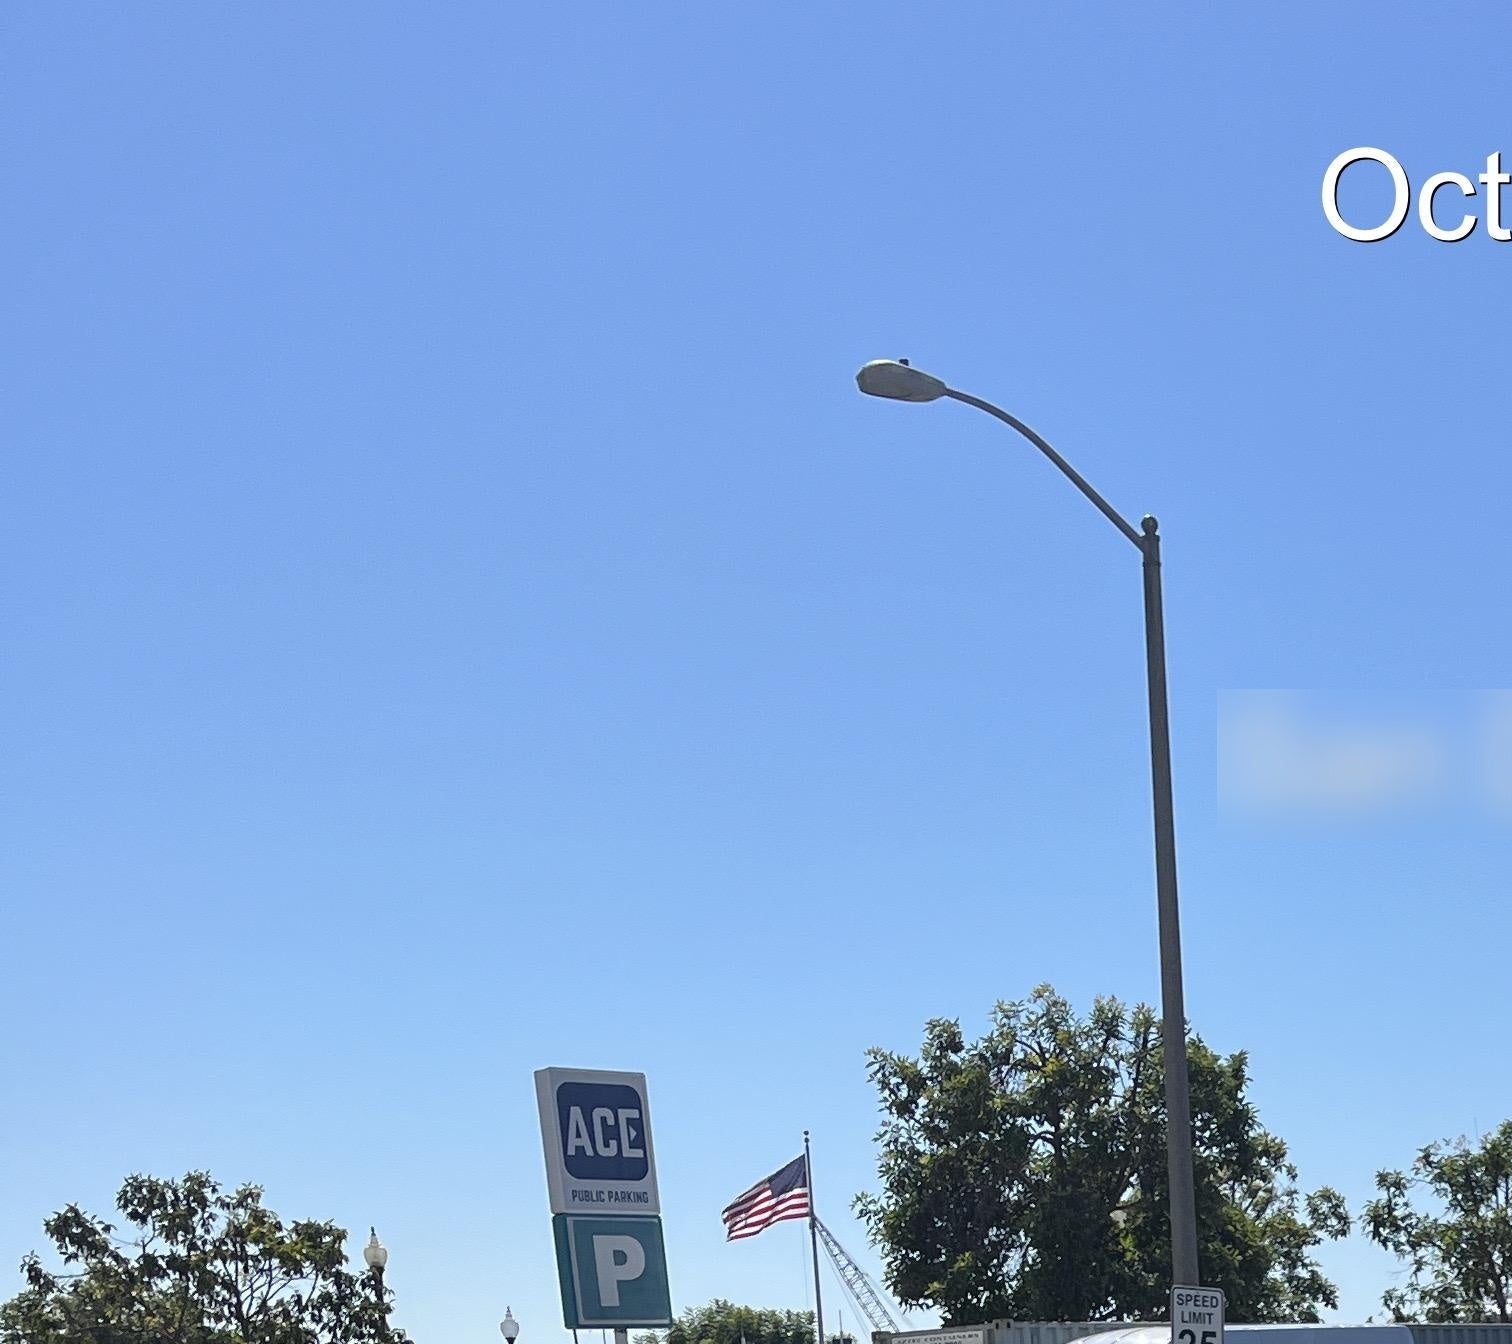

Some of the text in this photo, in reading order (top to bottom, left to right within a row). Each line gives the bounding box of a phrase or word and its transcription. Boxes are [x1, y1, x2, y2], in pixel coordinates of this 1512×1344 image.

[567, 1105, 645, 1159] ACE
[571, 1189, 649, 1205] PUBLIC PARKING
[593, 1234, 646, 1307] P
[1176, 1293, 1219, 1308] SPEED
[1181, 1310, 1214, 1325] LIMIT
